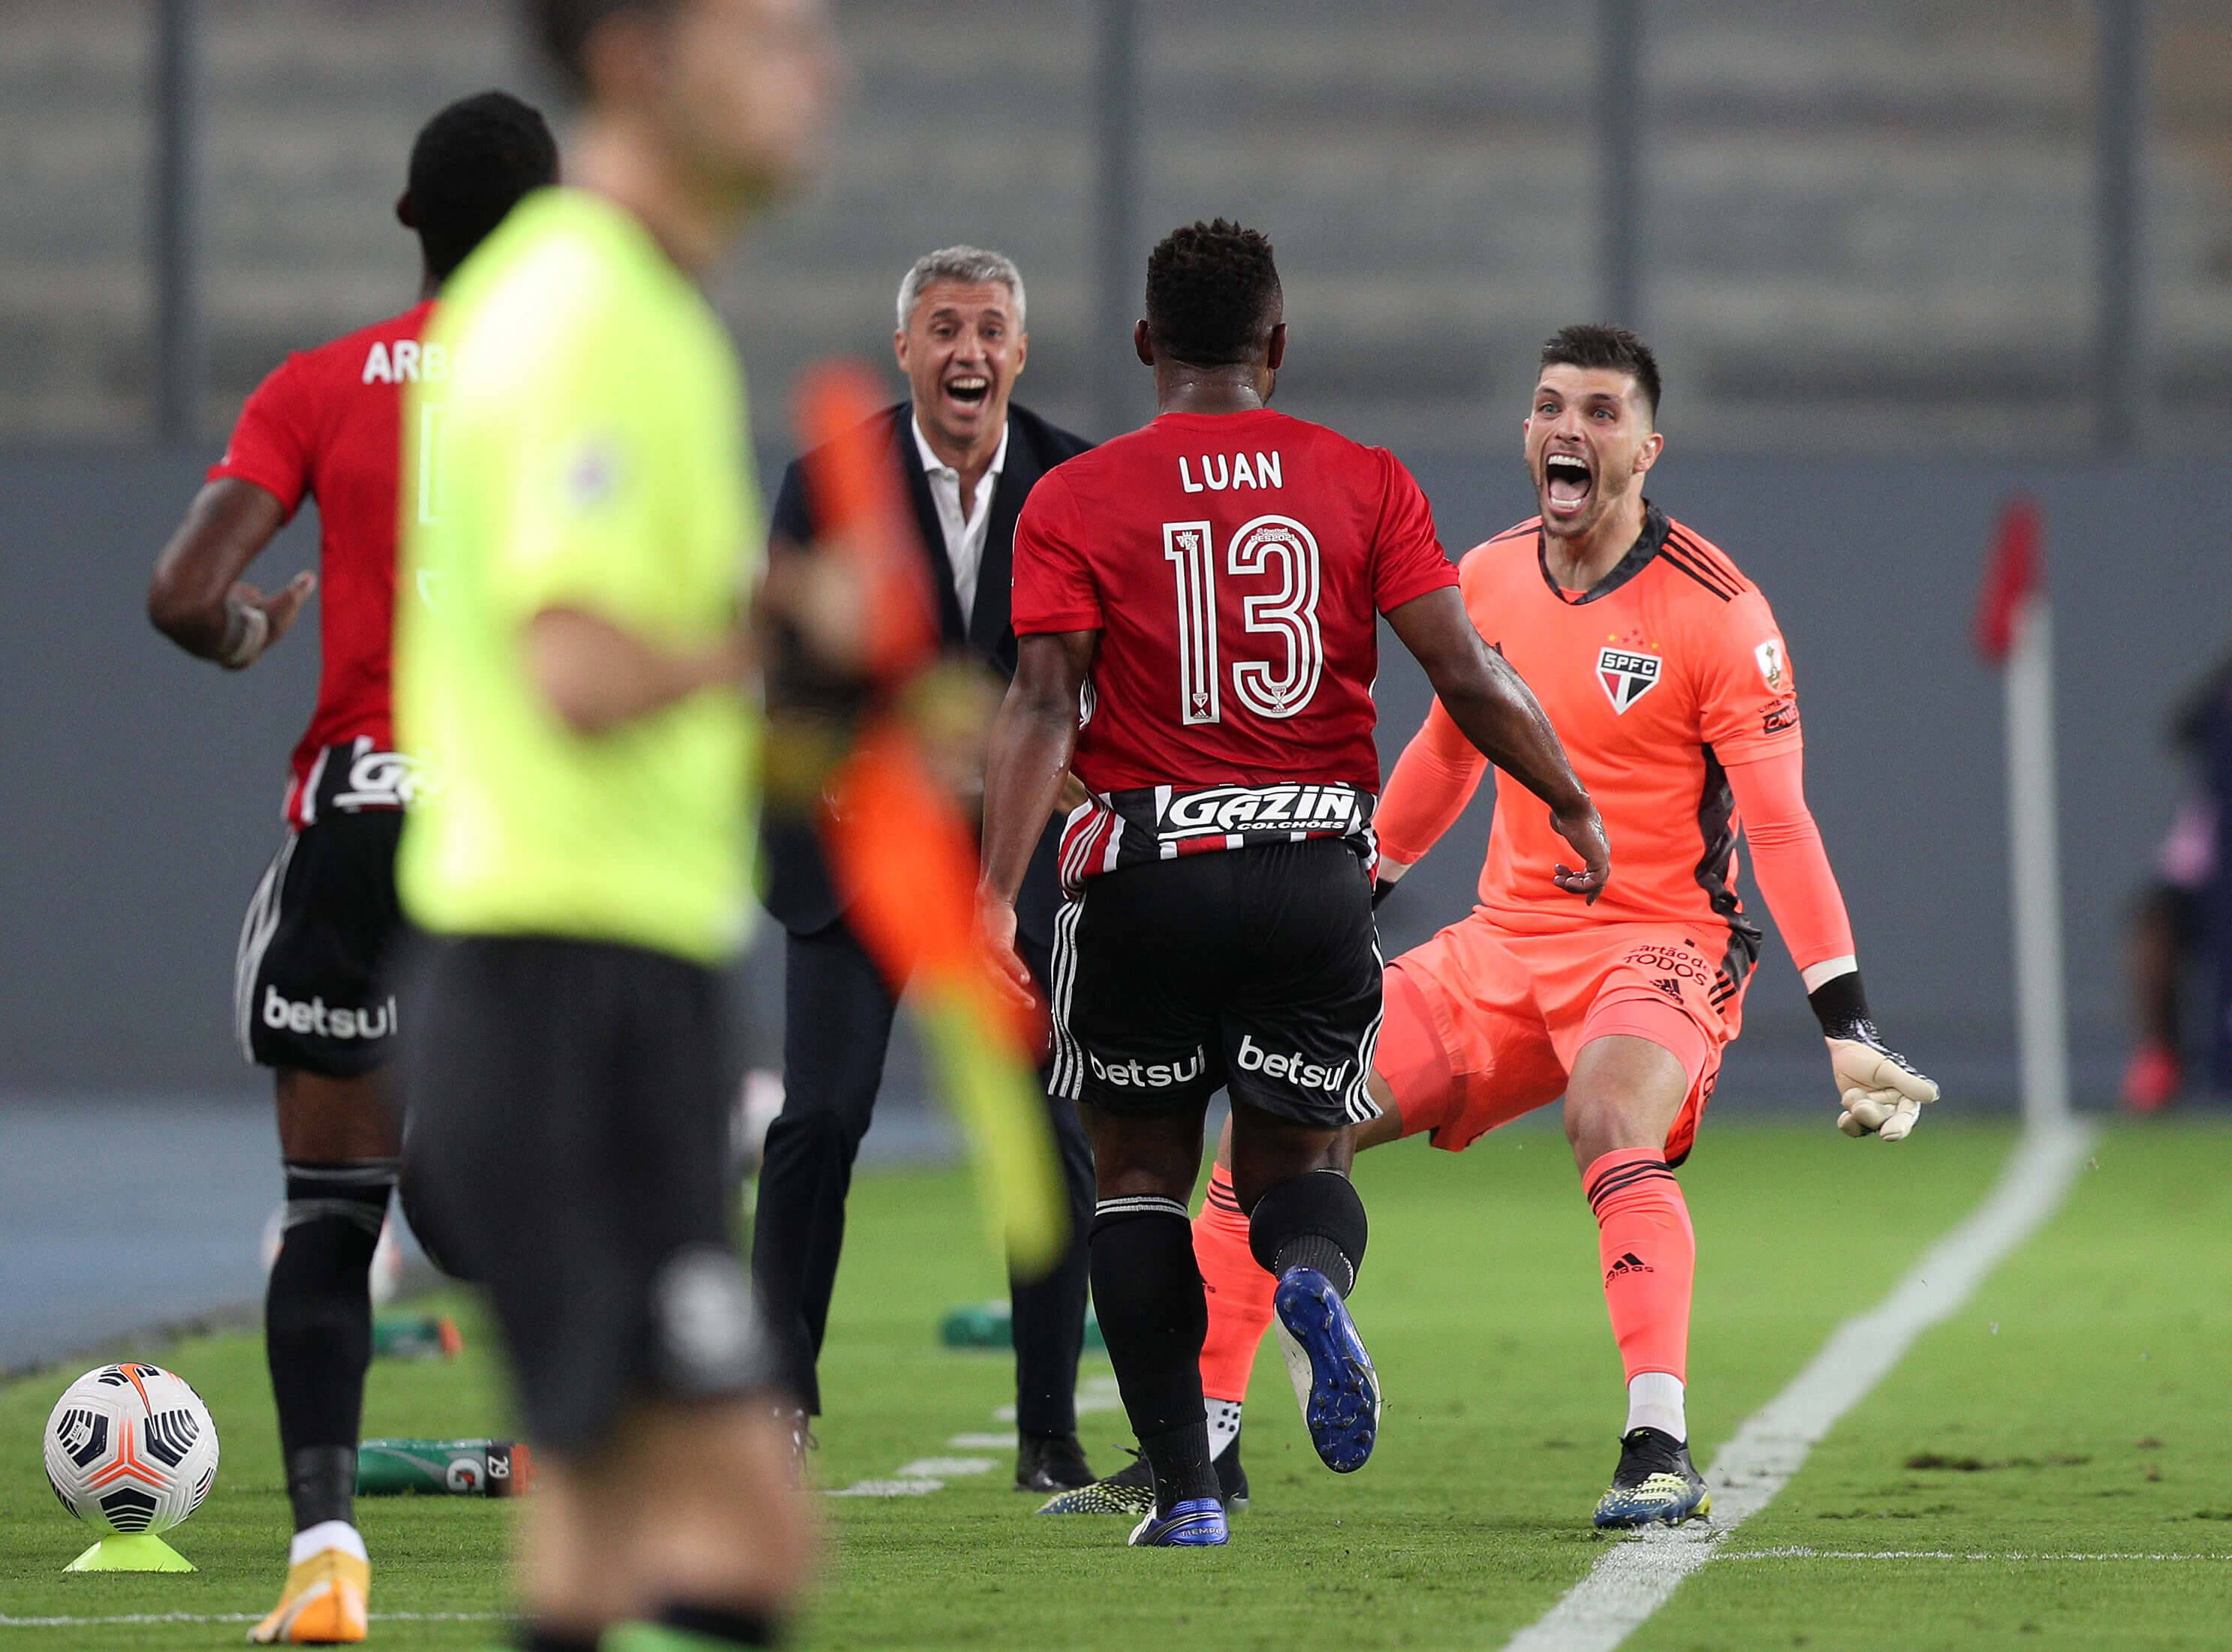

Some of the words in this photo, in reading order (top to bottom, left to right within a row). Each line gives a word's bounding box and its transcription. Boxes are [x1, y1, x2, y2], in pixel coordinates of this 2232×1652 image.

[1178, 450, 1283, 493] LUAN
[1162, 514, 1323, 725] 13
[1603, 654, 1655, 675] SPFC
[1169, 786, 1355, 830] GAZIN
[1236, 820, 1345, 830] COLCHÕES
[1623, 953, 1708, 986] TODOS
[264, 984, 397, 1039] betsul
[1088, 1044, 1206, 1088] betsul
[1237, 1034, 1351, 1091] betsul
[488, 1455, 509, 1479] 29
[1180, 1527, 1222, 1537] TIEMPO
